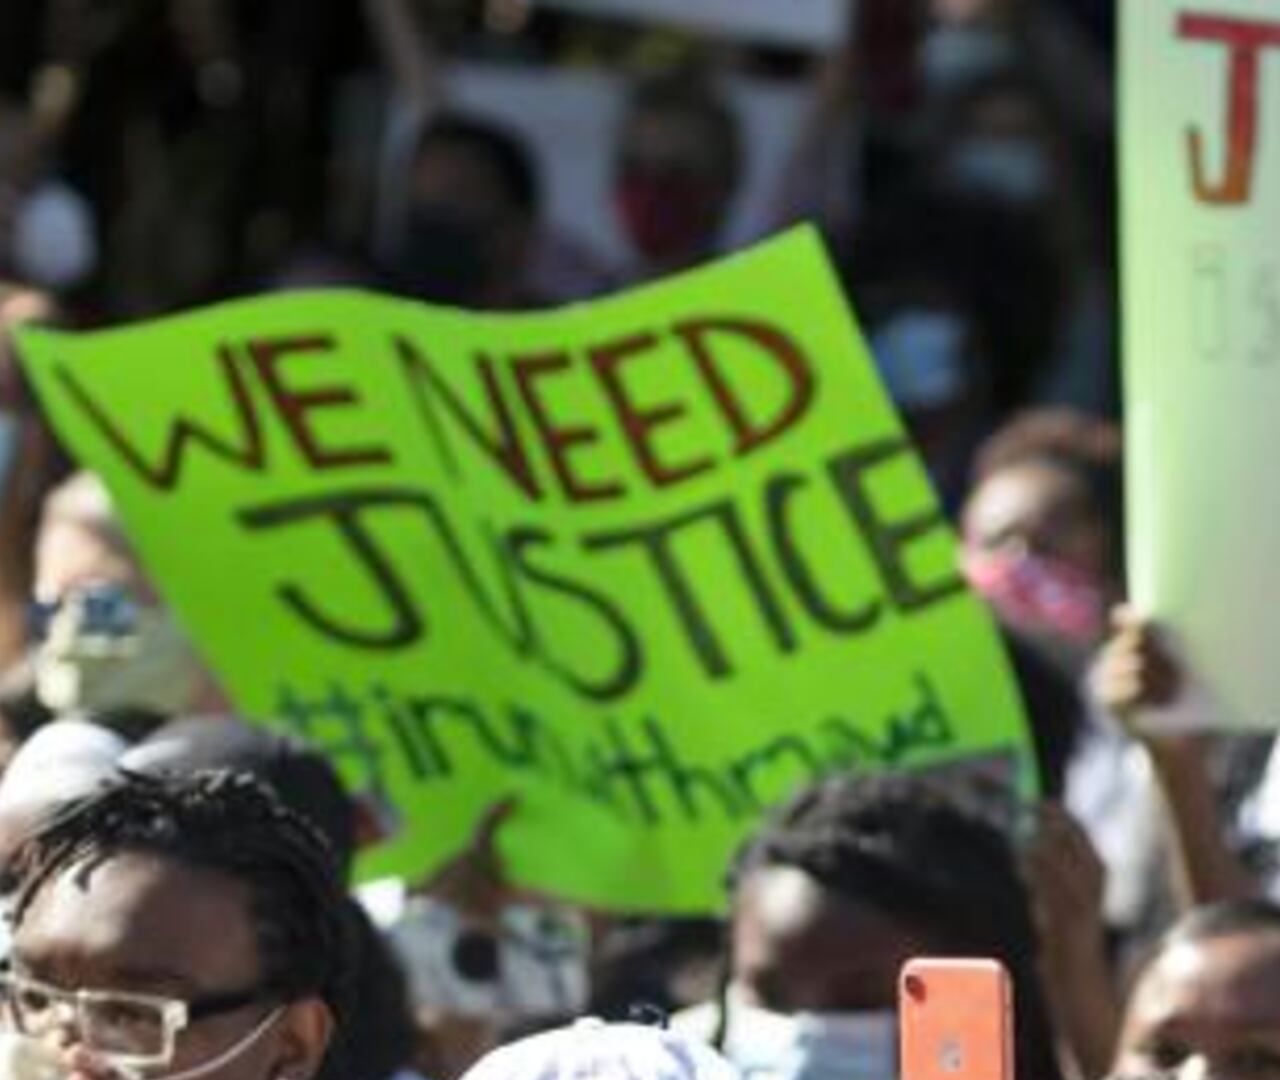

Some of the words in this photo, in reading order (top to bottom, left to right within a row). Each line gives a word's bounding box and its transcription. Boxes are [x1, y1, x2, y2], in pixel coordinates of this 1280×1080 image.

[54, 332, 392, 494] WE
[394, 313, 817, 506] NEED
[235, 437, 970, 703] JUSTICE
